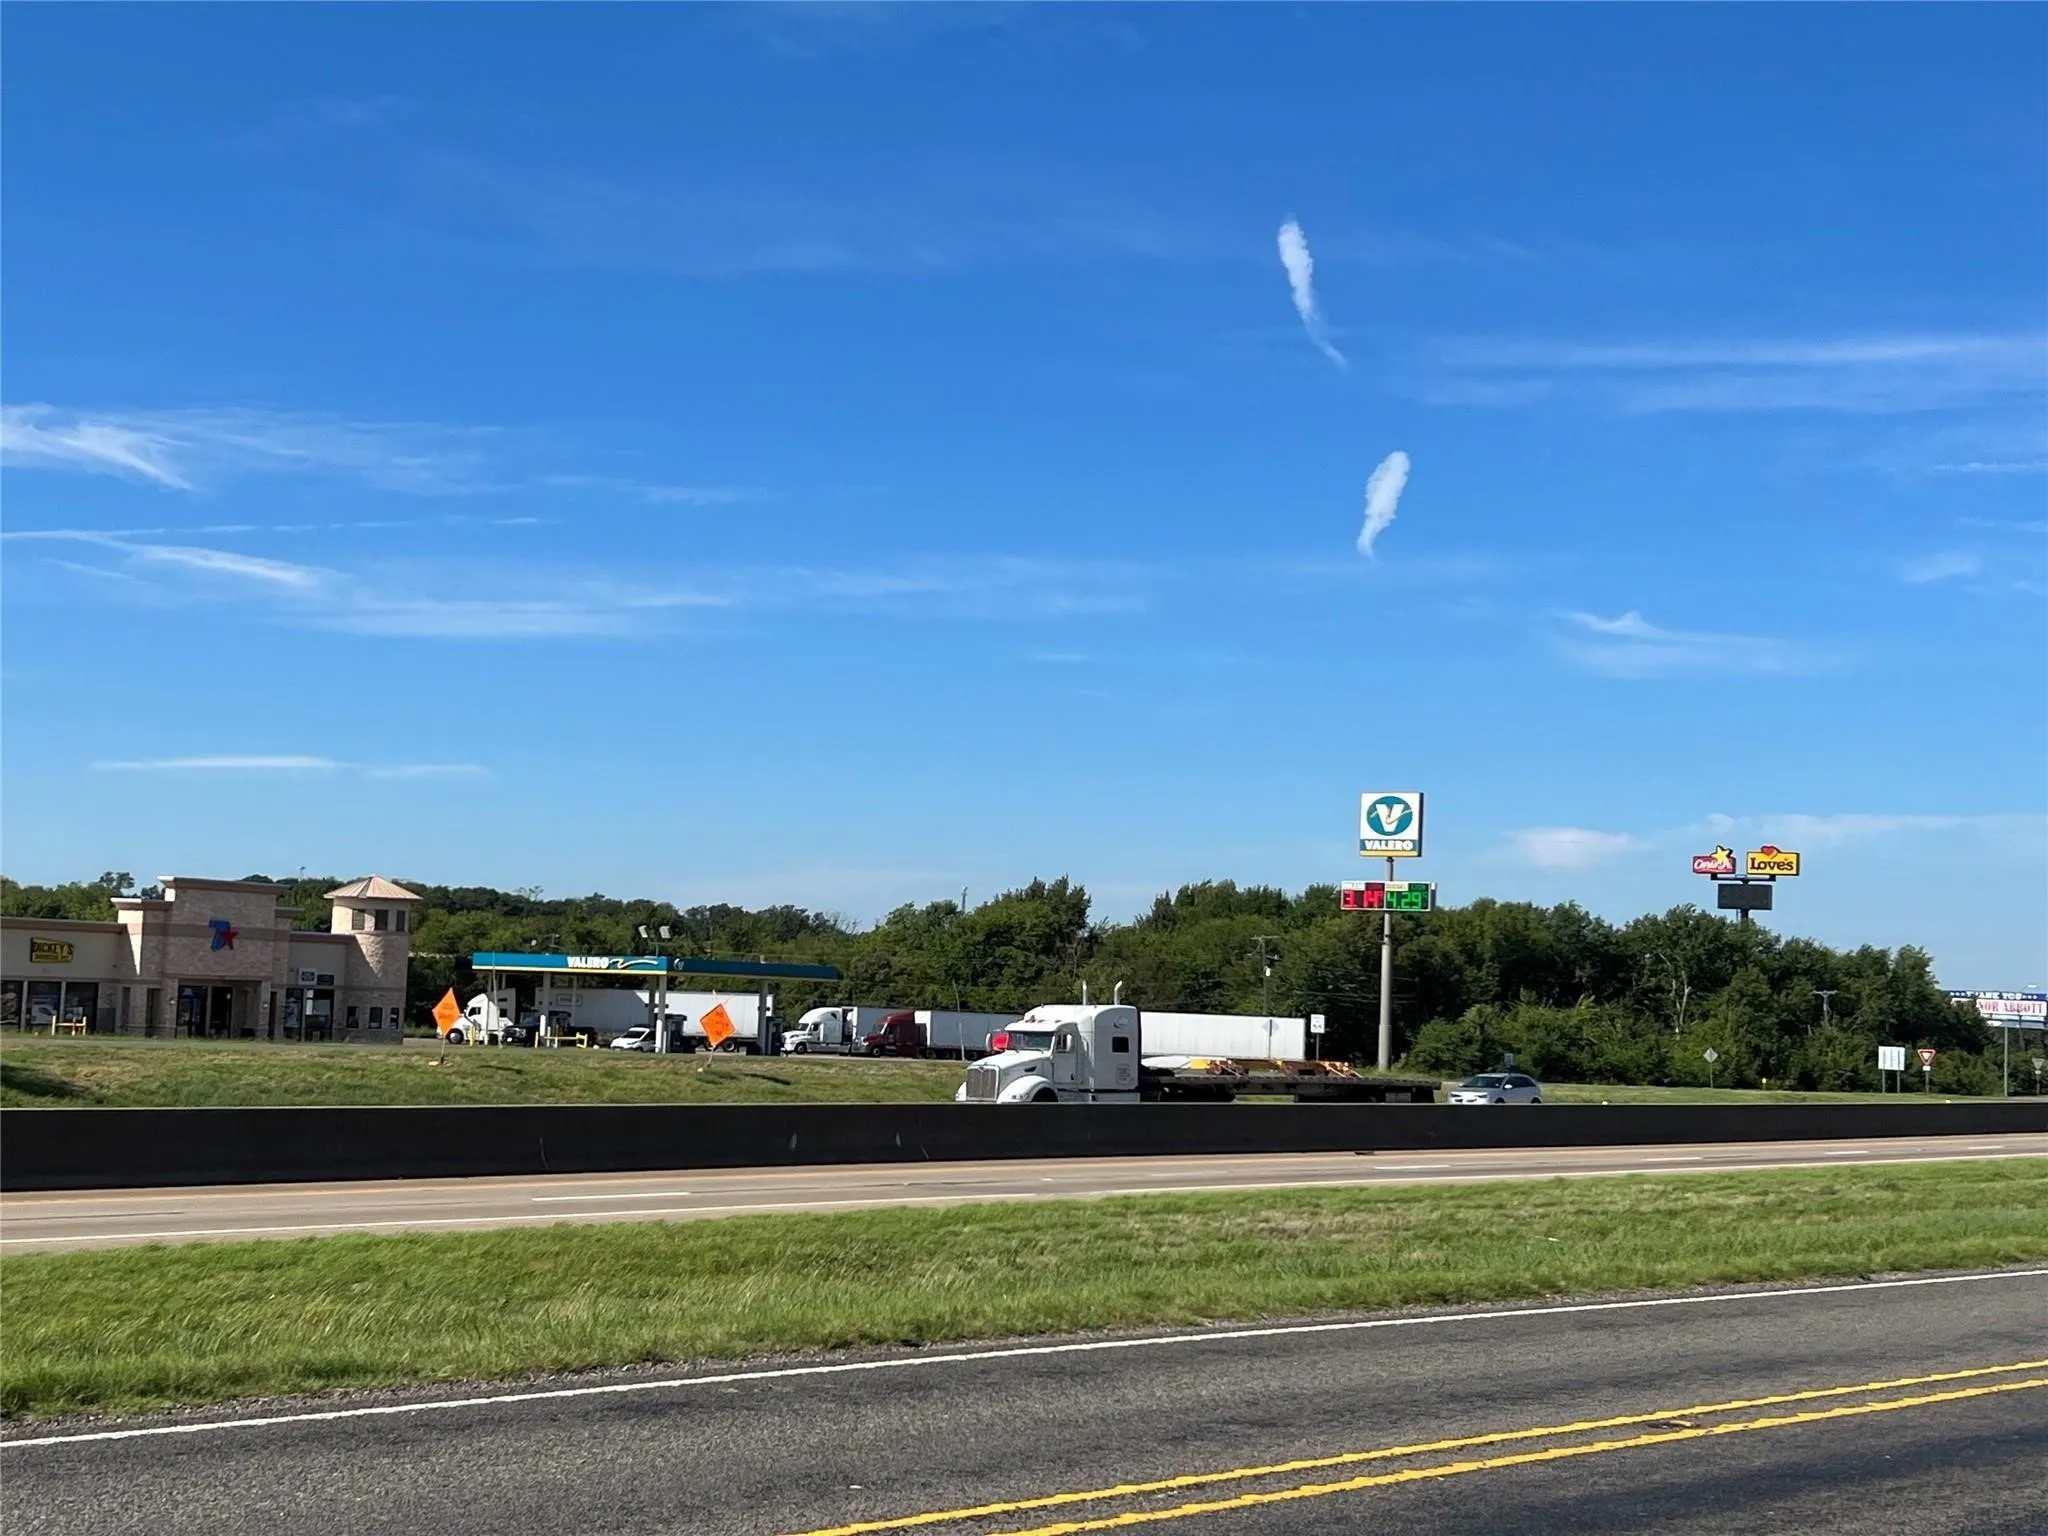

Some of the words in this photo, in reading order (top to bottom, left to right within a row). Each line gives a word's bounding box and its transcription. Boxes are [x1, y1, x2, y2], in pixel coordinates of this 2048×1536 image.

[1365, 840, 1413, 850] VALERO
[1750, 857, 1794, 871] Love's
[567, 956, 610, 968] VALERO
